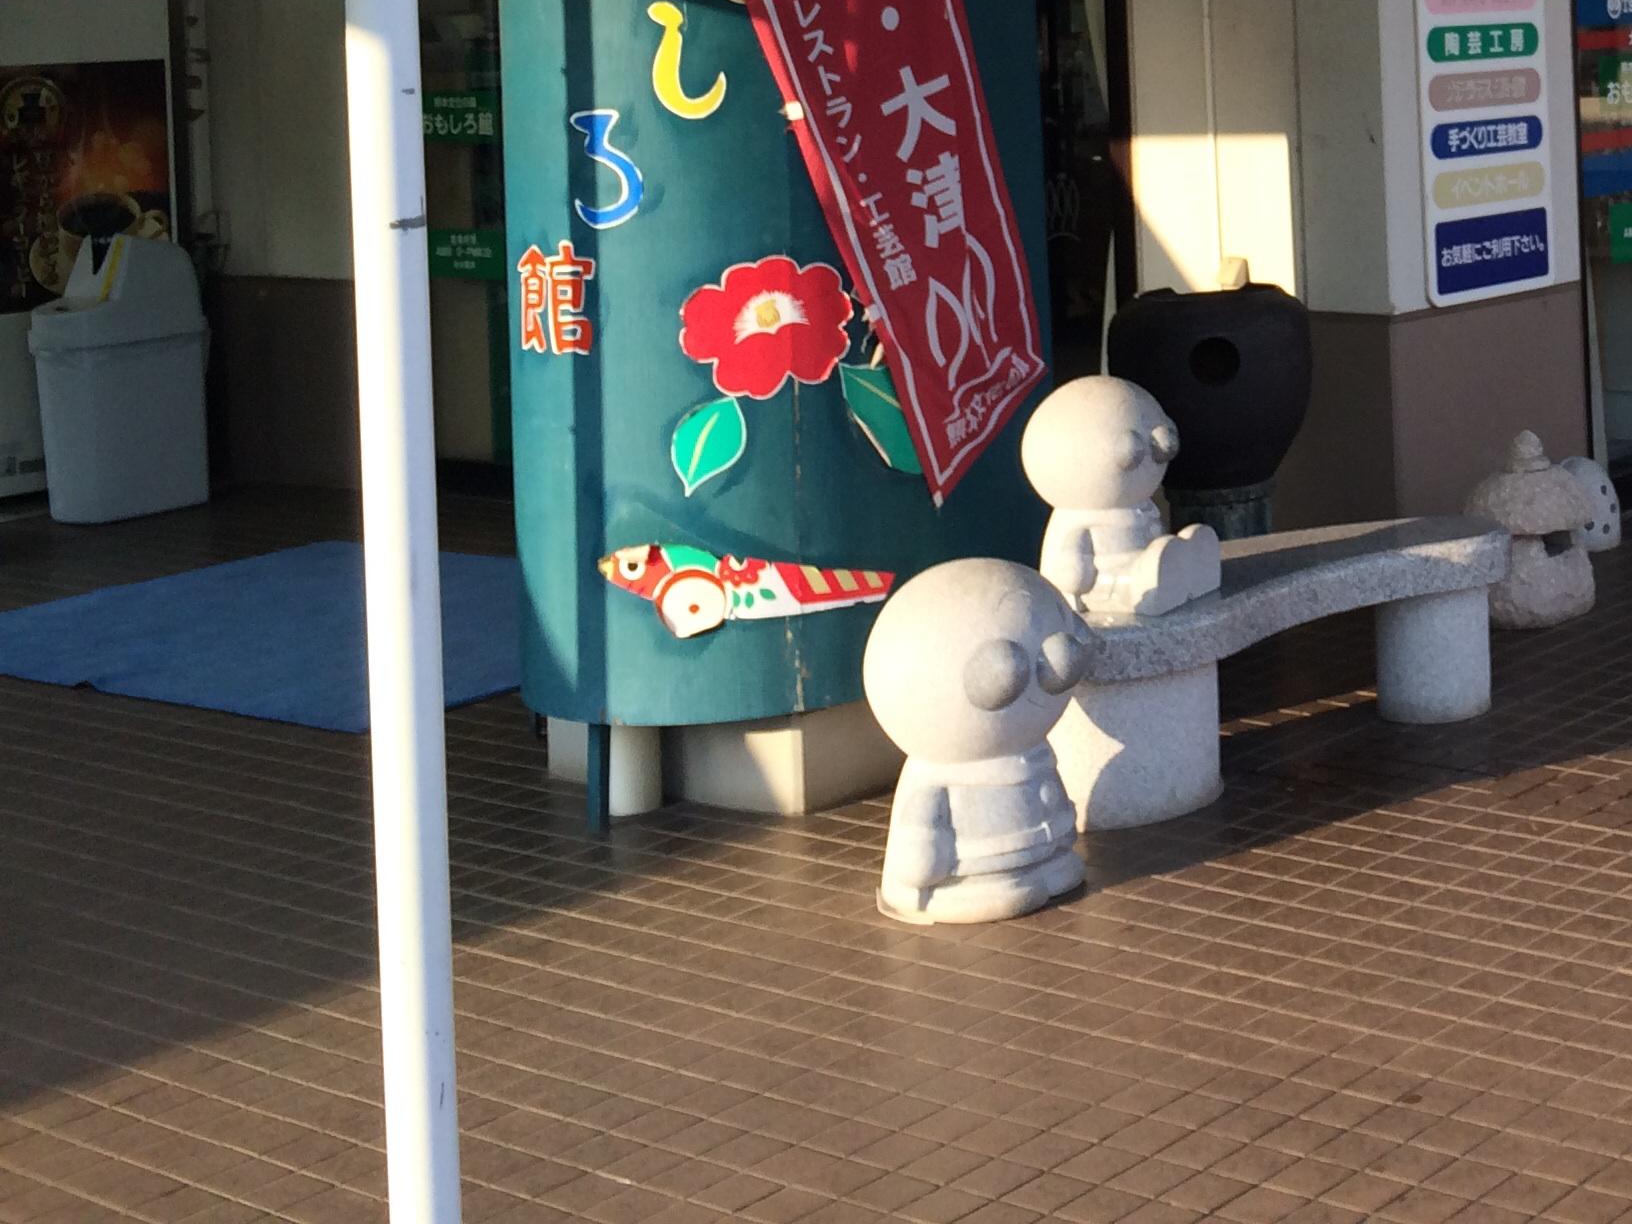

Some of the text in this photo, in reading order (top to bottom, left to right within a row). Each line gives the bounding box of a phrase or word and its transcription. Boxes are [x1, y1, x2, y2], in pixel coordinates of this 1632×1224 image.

[1444, 28, 1525, 57] 陶芸工房
[1448, 122, 1529, 153] 手づくり工芸教室
